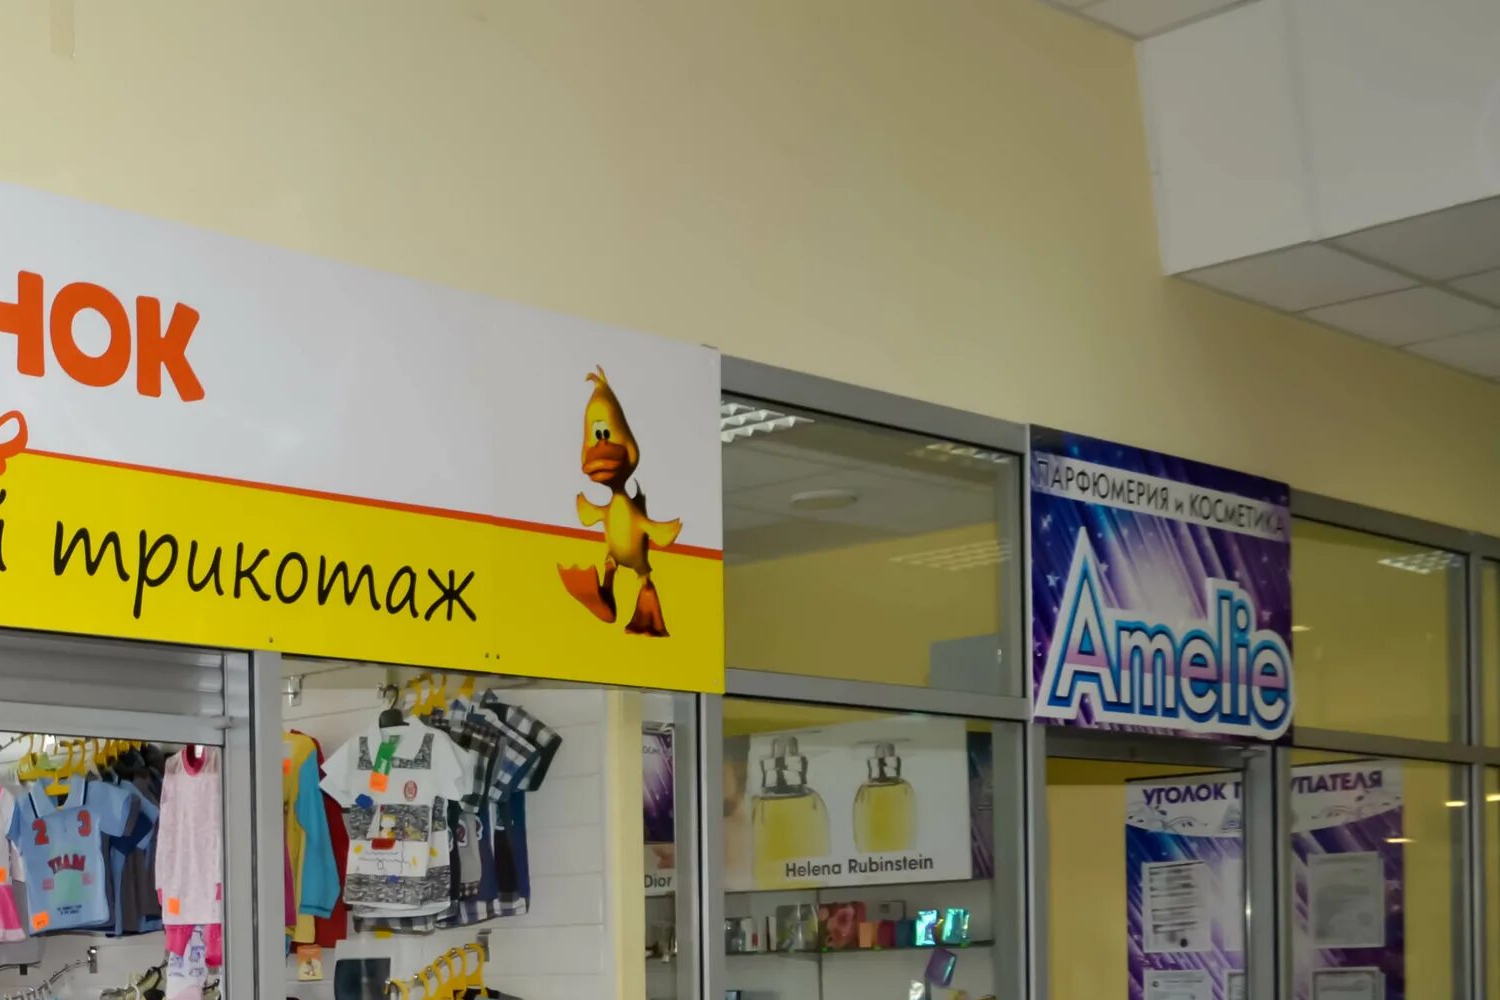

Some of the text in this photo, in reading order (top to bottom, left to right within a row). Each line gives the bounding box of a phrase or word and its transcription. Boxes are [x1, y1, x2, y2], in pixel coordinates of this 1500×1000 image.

[1036, 458, 1169, 511] ПАРФЮМЕРИЯ
[1189, 492, 1284, 533] КОСМЕТИКА
[53, 520, 477, 620] трикотаж
[1045, 548, 1290, 733] Amelie
[1143, 783, 1228, 806] УГОЛОК
[644, 873, 672, 888] Dior
[785, 853, 933, 878] Helena Rubinstein
